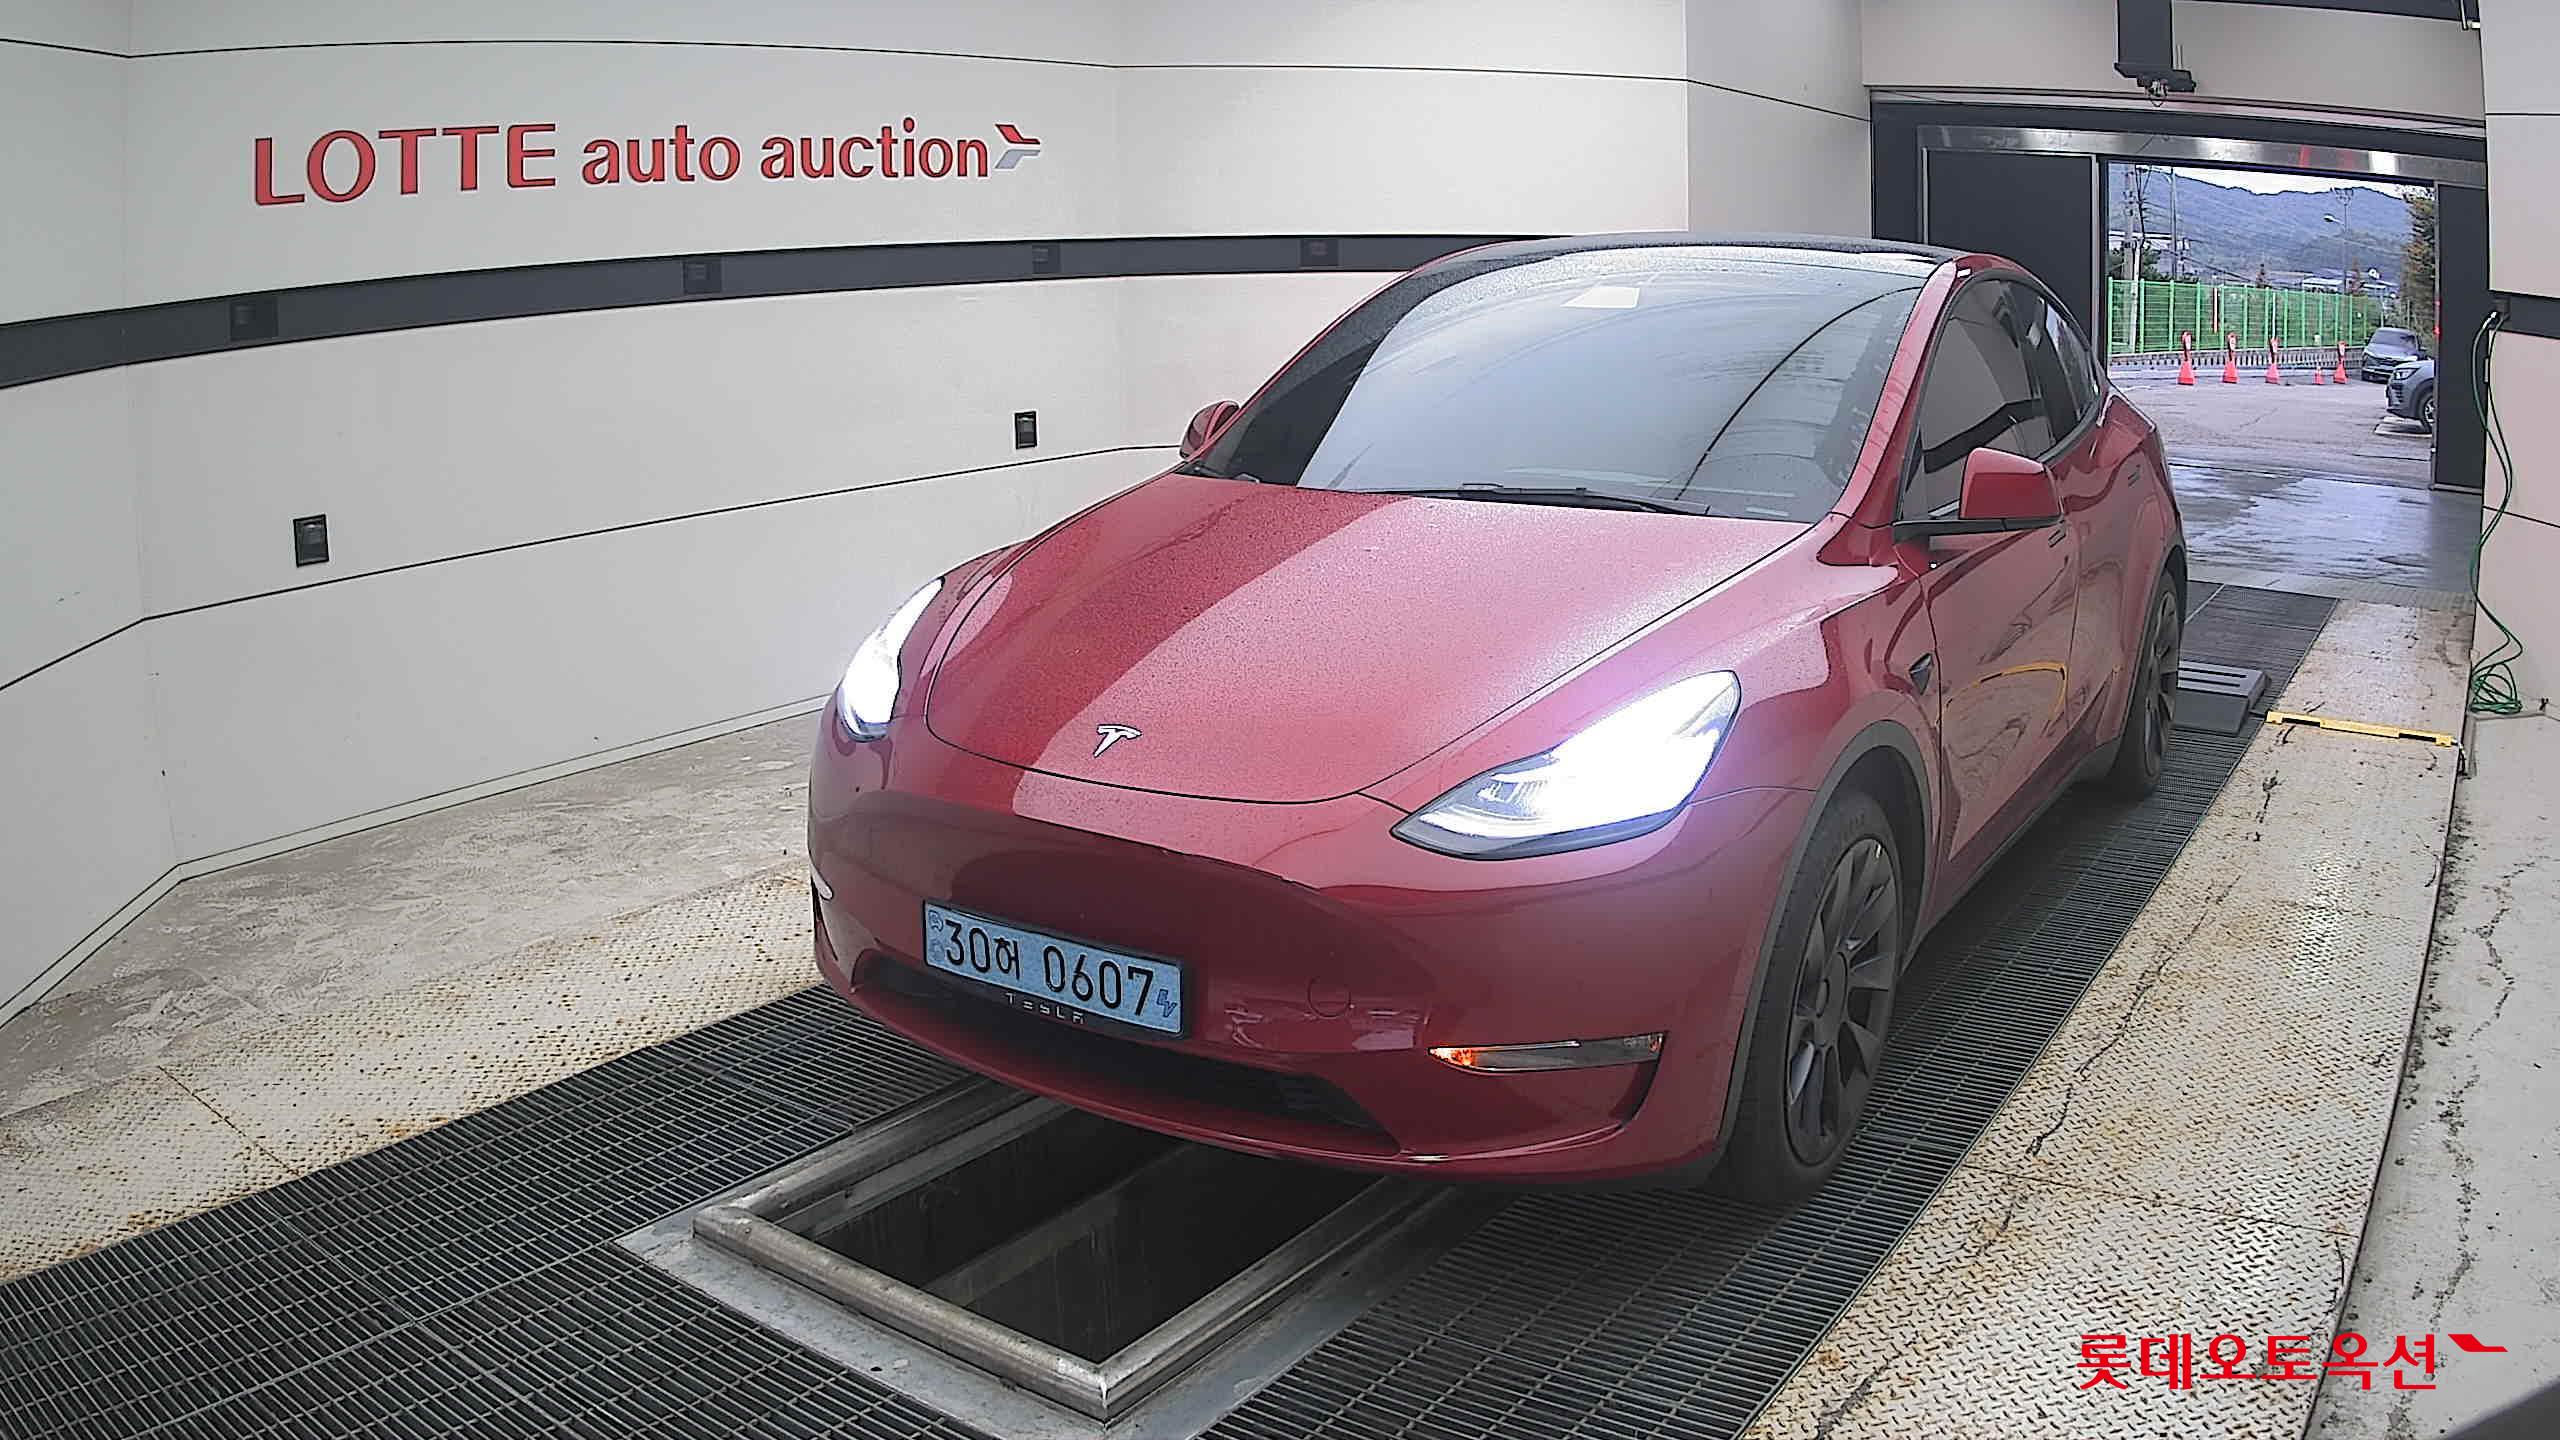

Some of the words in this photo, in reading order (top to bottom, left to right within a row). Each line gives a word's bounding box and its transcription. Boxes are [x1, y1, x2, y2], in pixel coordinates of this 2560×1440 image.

[254, 123, 557, 207] LOTTE
[581, 123, 742, 187] auto
[760, 116, 989, 180] auction
[945, 918, 1021, 981] 30허
[1043, 944, 1154, 1016] 0607
[1005, 991, 1086, 1025] TESLA
